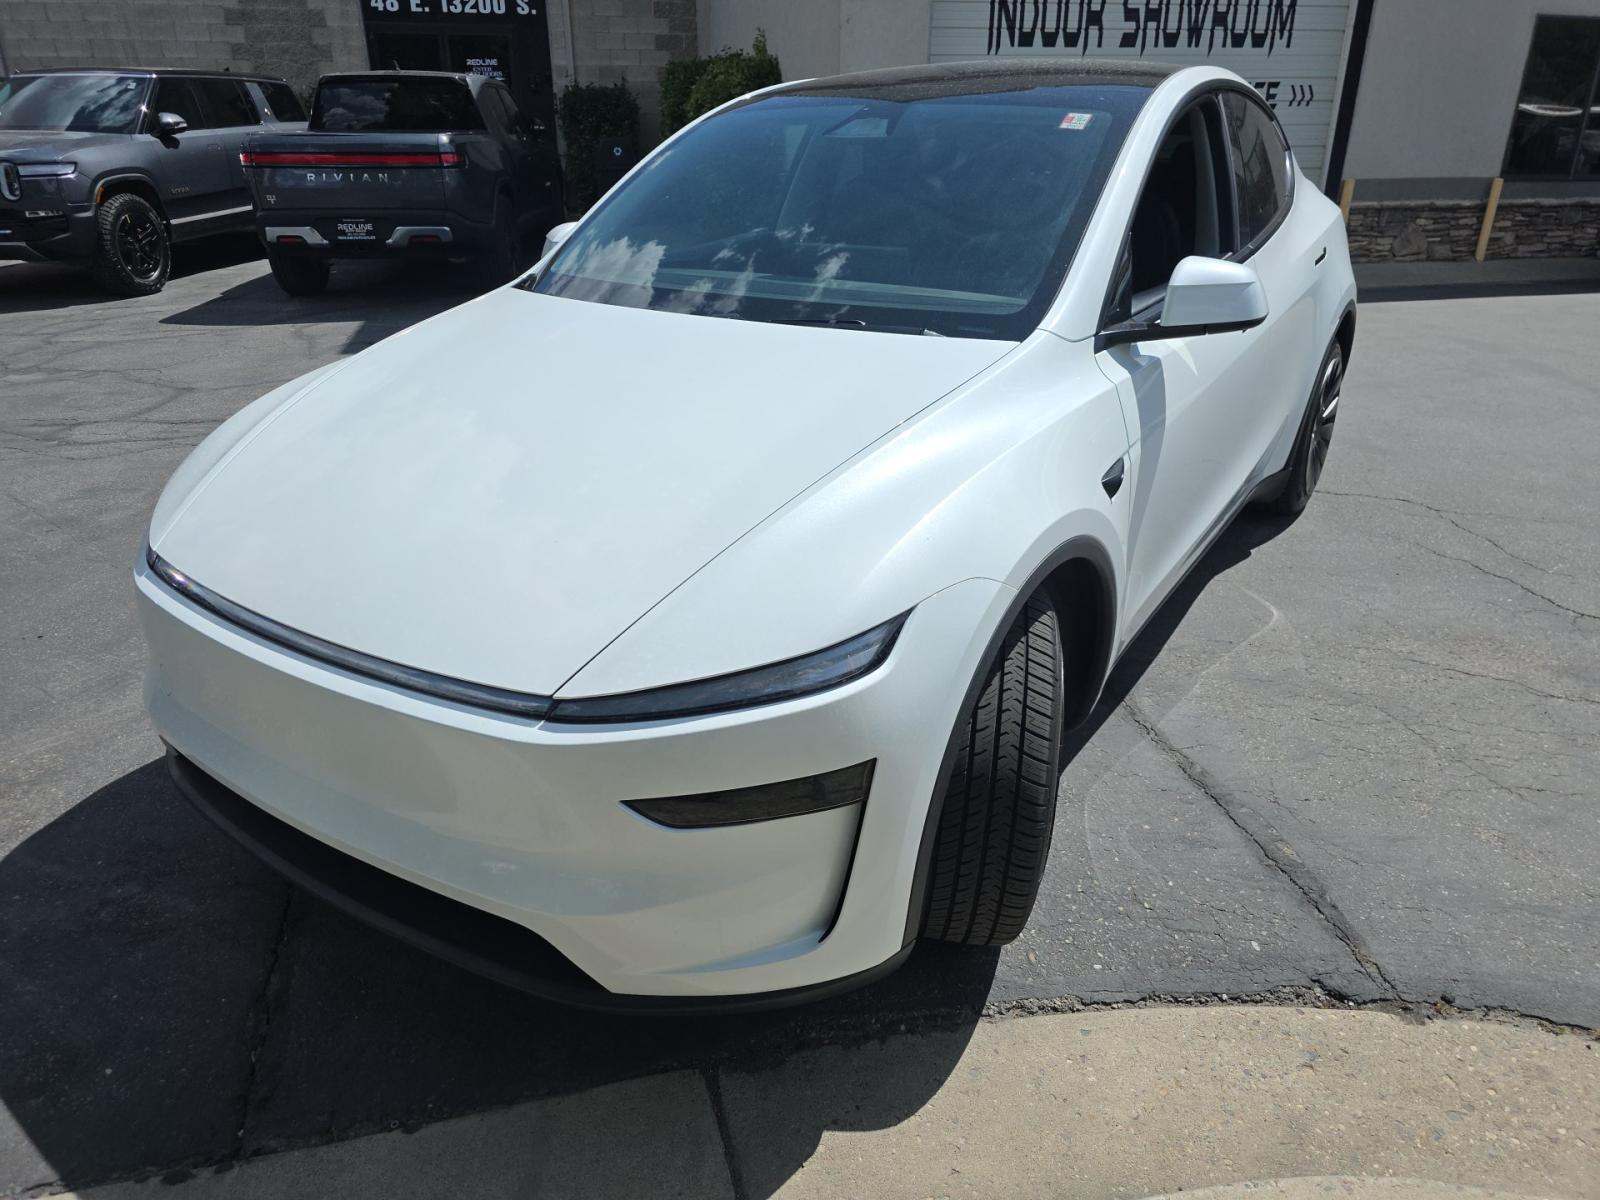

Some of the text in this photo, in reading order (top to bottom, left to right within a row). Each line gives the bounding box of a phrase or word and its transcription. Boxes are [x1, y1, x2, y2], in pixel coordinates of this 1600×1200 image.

[410, 0, 430, 13] E.
[441, 0, 506, 14] 13200
[516, 0, 537, 15] S.
[987, 0, 1297, 58] INDOOR SHOWROOM
[466, 58, 498, 66] REDLINE
[307, 173, 389, 182] RIVIAN
[337, 223, 374, 231] REDLINE
